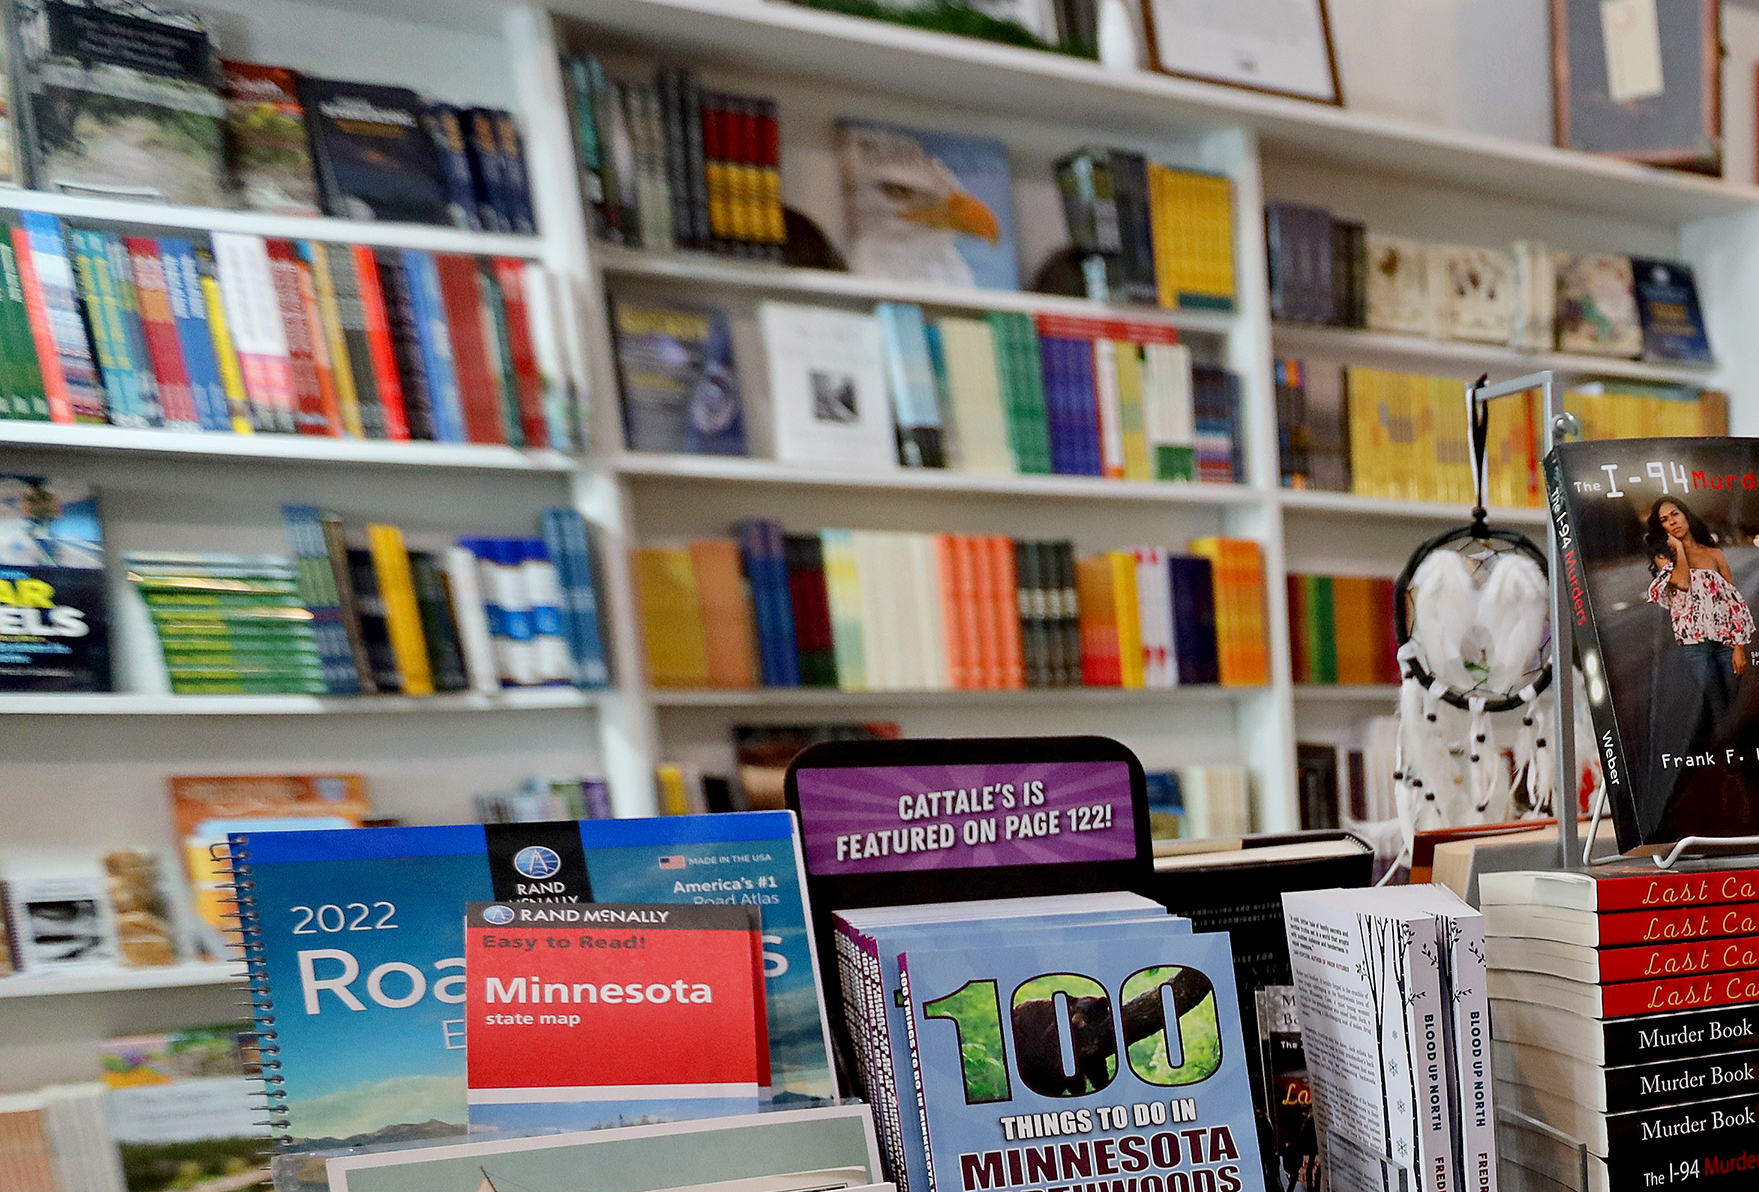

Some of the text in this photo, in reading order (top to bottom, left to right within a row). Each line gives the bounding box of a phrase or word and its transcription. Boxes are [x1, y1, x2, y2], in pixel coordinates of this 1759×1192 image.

[1574, 480, 1601, 493] The
[1601, 462, 1689, 498] I-94
[1661, 751, 1717, 770] Frank
[1726, 750, 1745, 766] F.
[899, 780, 1045, 821] CATTALE'S IS
[836, 803, 1113, 862] FEATURED ON PAGE 122!
[516, 881, 566, 896] RAND
[673, 876, 778, 895] America's #1
[1642, 878, 1709, 905] Last
[290, 901, 399, 935] 2022
[521, 909, 580, 922] RAND
[482, 935, 647, 952] Easy to Read!
[297, 948, 466, 1015] Roa
[486, 977, 713, 1005] Minnesota
[486, 1012, 581, 1028] state map
[924, 963, 1224, 1106] 100
[1638, 1027, 1704, 1050] Murder
[1710, 1018, 1754, 1041] Book
[1424, 1013, 1438, 1060] BLOOD
[1428, 1063, 1439, 1085] UP
[1000, 1098, 1197, 1142] THINGS TO DO IN
[1429, 1086, 1442, 1132] NORTH
[958, 1124, 1240, 1192] MINNESOTA
[1644, 1170, 1665, 1187] The
[1668, 1158, 1700, 1183] I-94
